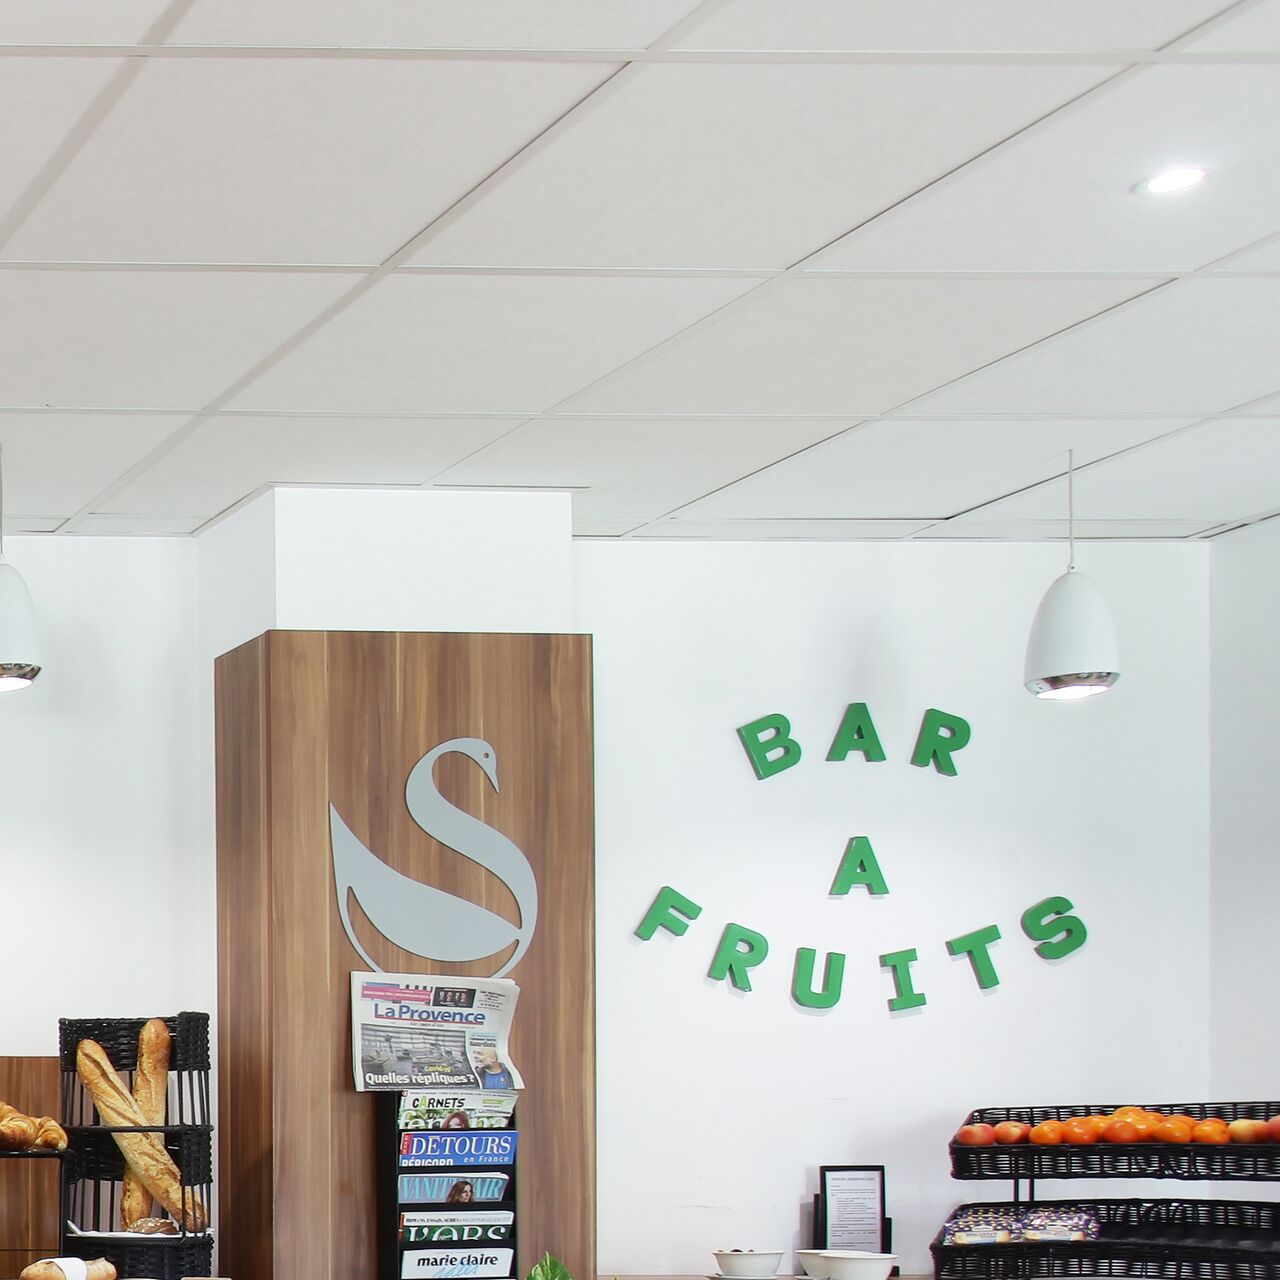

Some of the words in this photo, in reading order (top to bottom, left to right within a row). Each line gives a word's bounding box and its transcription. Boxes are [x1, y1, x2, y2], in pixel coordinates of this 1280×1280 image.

[736, 702, 971, 780] BAR
[829, 836, 889, 895] A
[633, 886, 1087, 1012] FRUITS
[374, 1003, 395, 1018] La
[399, 1005, 486, 1023] Provence
[365, 1072, 410, 1084] Quelles
[412, 1096, 466, 1109] CARNETS
[478, 1155, 509, 1163] France
[417, 1254, 458, 1267] marie
[460, 1253, 498, 1266] claire
